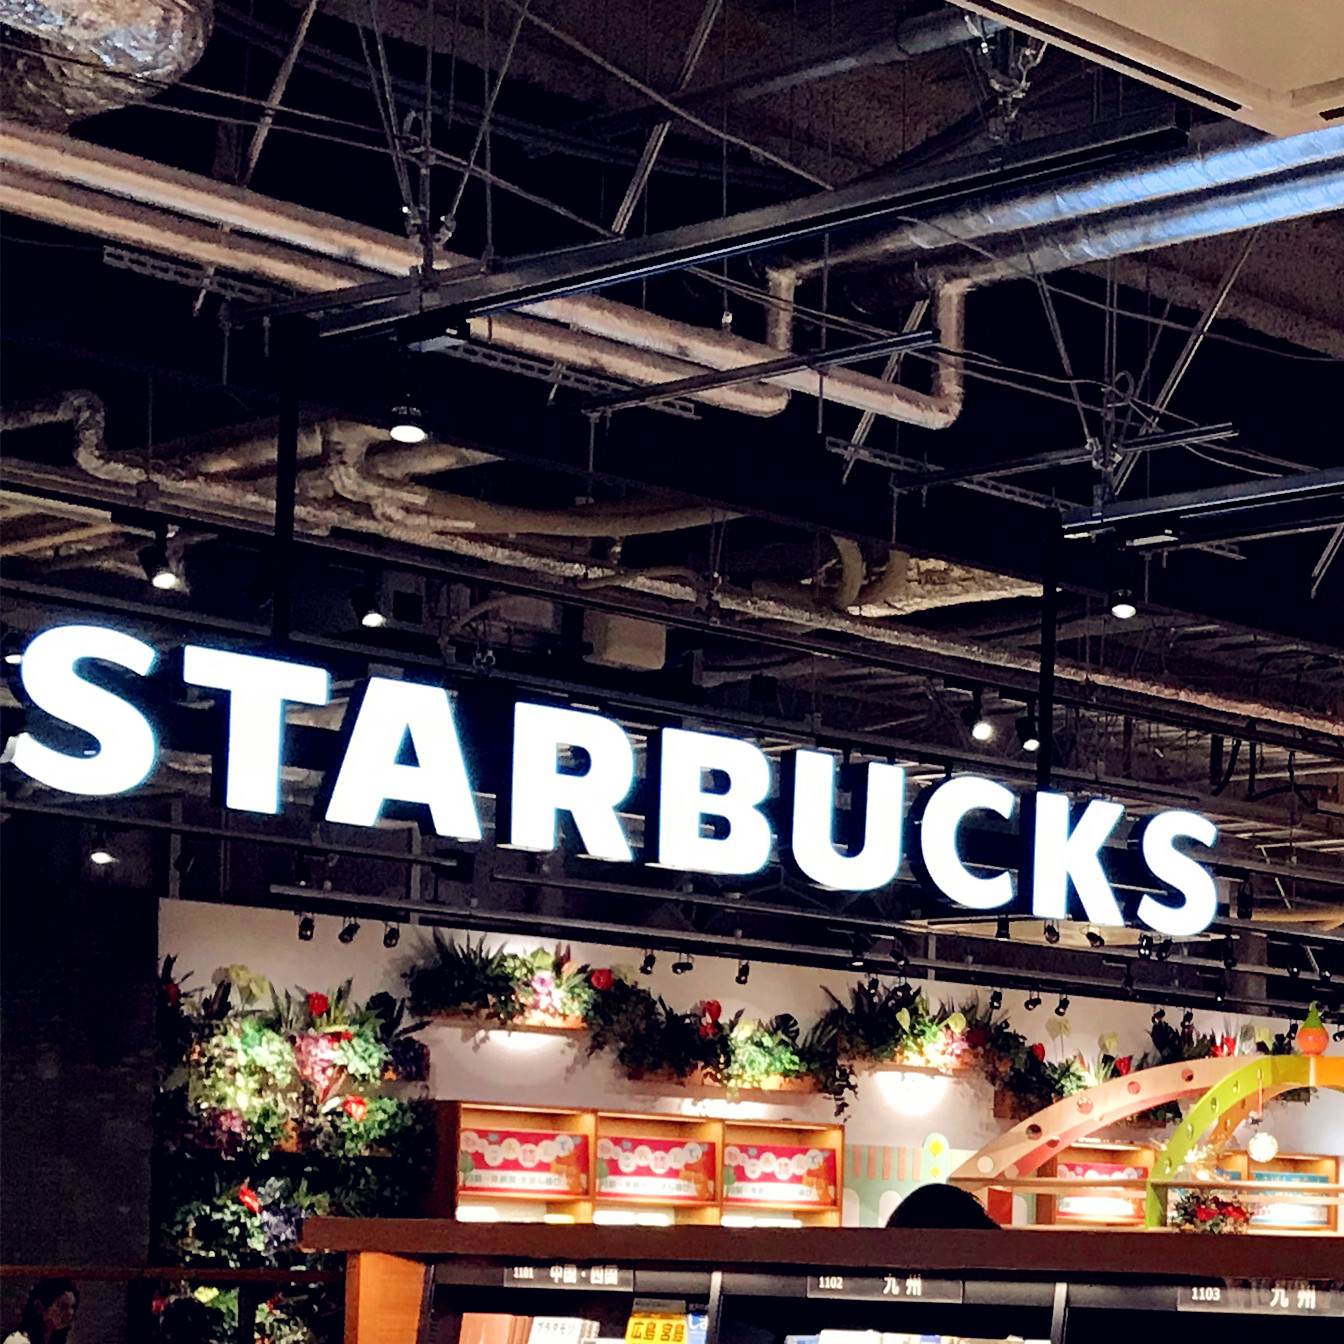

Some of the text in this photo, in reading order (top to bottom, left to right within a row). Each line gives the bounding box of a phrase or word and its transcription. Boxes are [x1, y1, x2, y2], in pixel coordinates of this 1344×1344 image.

[5, 624, 1219, 937] STARBUCKS
[513, 1267, 533, 1279] 1101
[550, 1265, 618, 1284] 中国・四国
[818, 1276, 843, 1289] 1102
[883, 1275, 922, 1295] 九州
[1192, 1288, 1220, 1301] 1103
[1270, 1287, 1316, 1309] 九州
[631, 1321, 684, 1342] 広島 宮島
